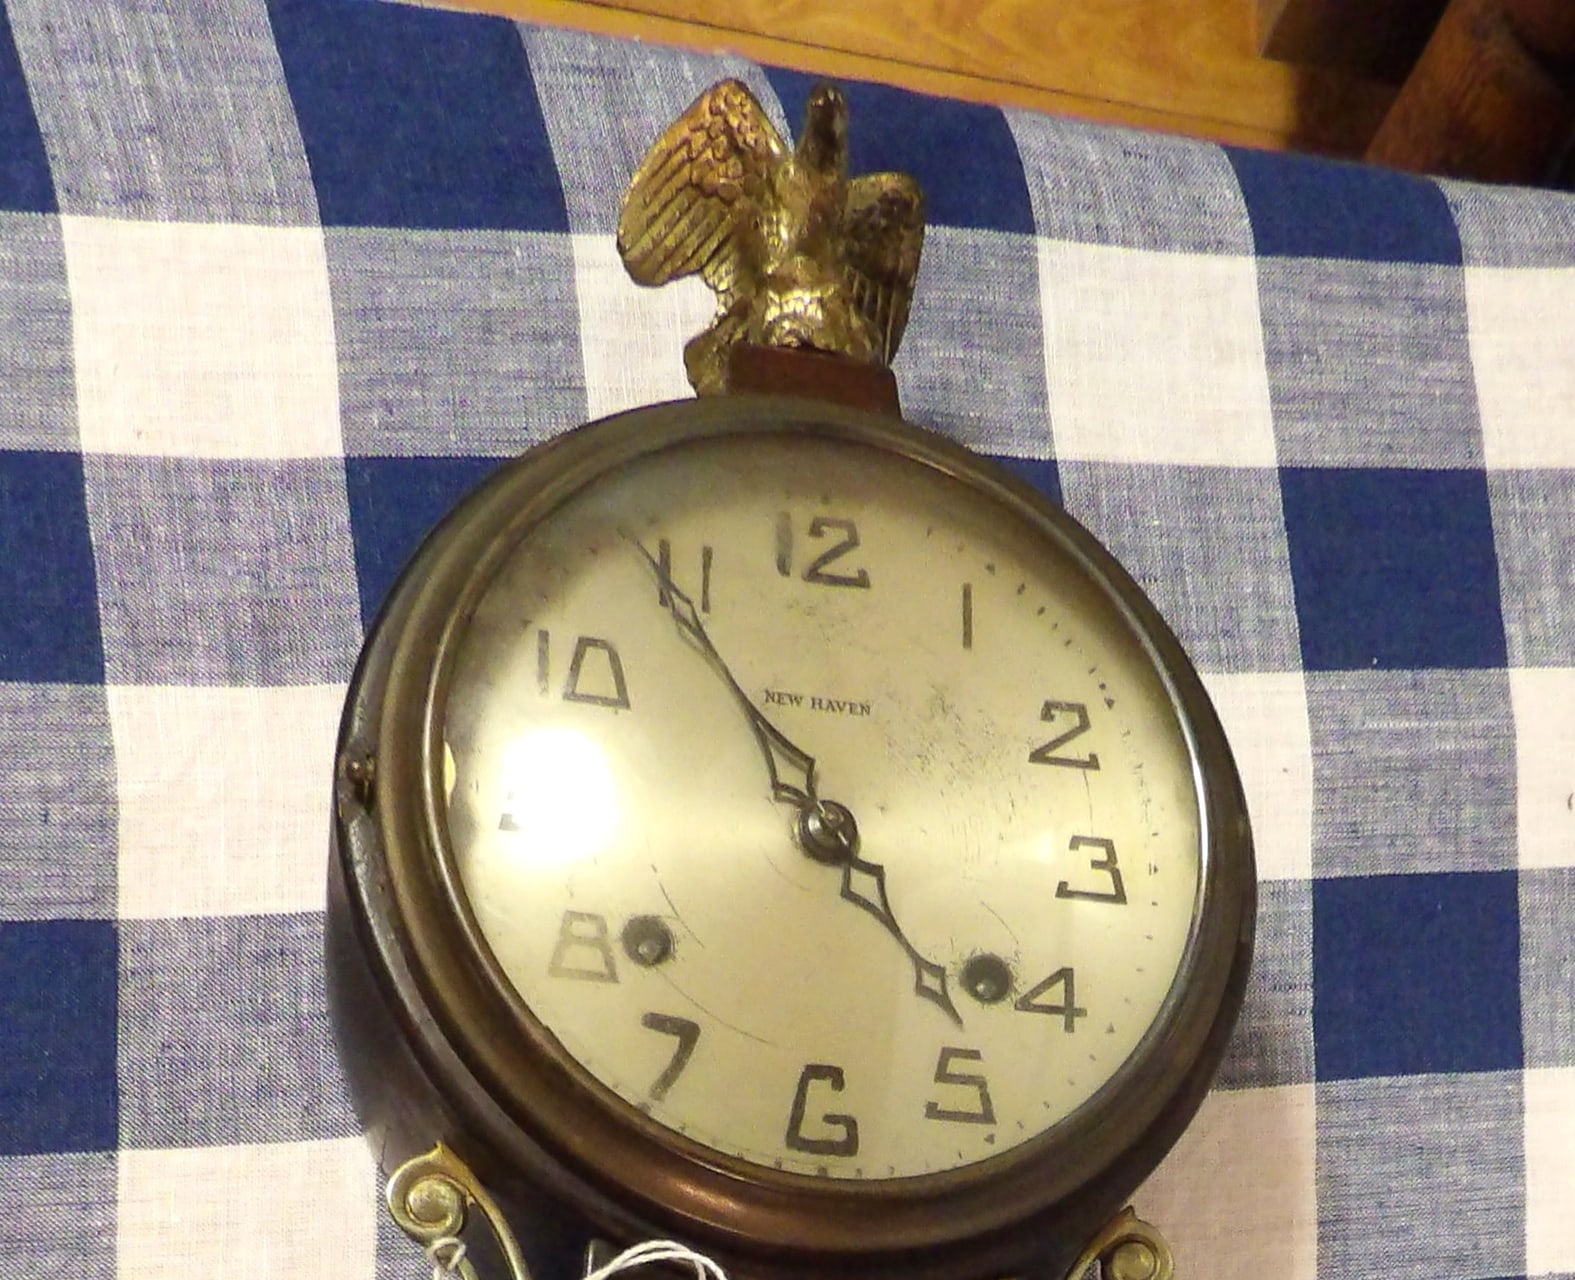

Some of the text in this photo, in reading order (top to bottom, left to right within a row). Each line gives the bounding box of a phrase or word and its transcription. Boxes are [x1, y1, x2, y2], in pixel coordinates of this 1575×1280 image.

[658, 538, 714, 614] 11
[774, 511, 871, 589] 12
[537, 629, 631, 710] 10
[764, 689, 871, 716] NEW HAVEN
[1028, 700, 1101, 771] 2
[1055, 834, 1128, 905] 3
[547, 909, 620, 984] 8
[1013, 967, 1088, 1034] 4
[640, 1011, 701, 1101] 7
[924, 1046, 998, 1125] 5
